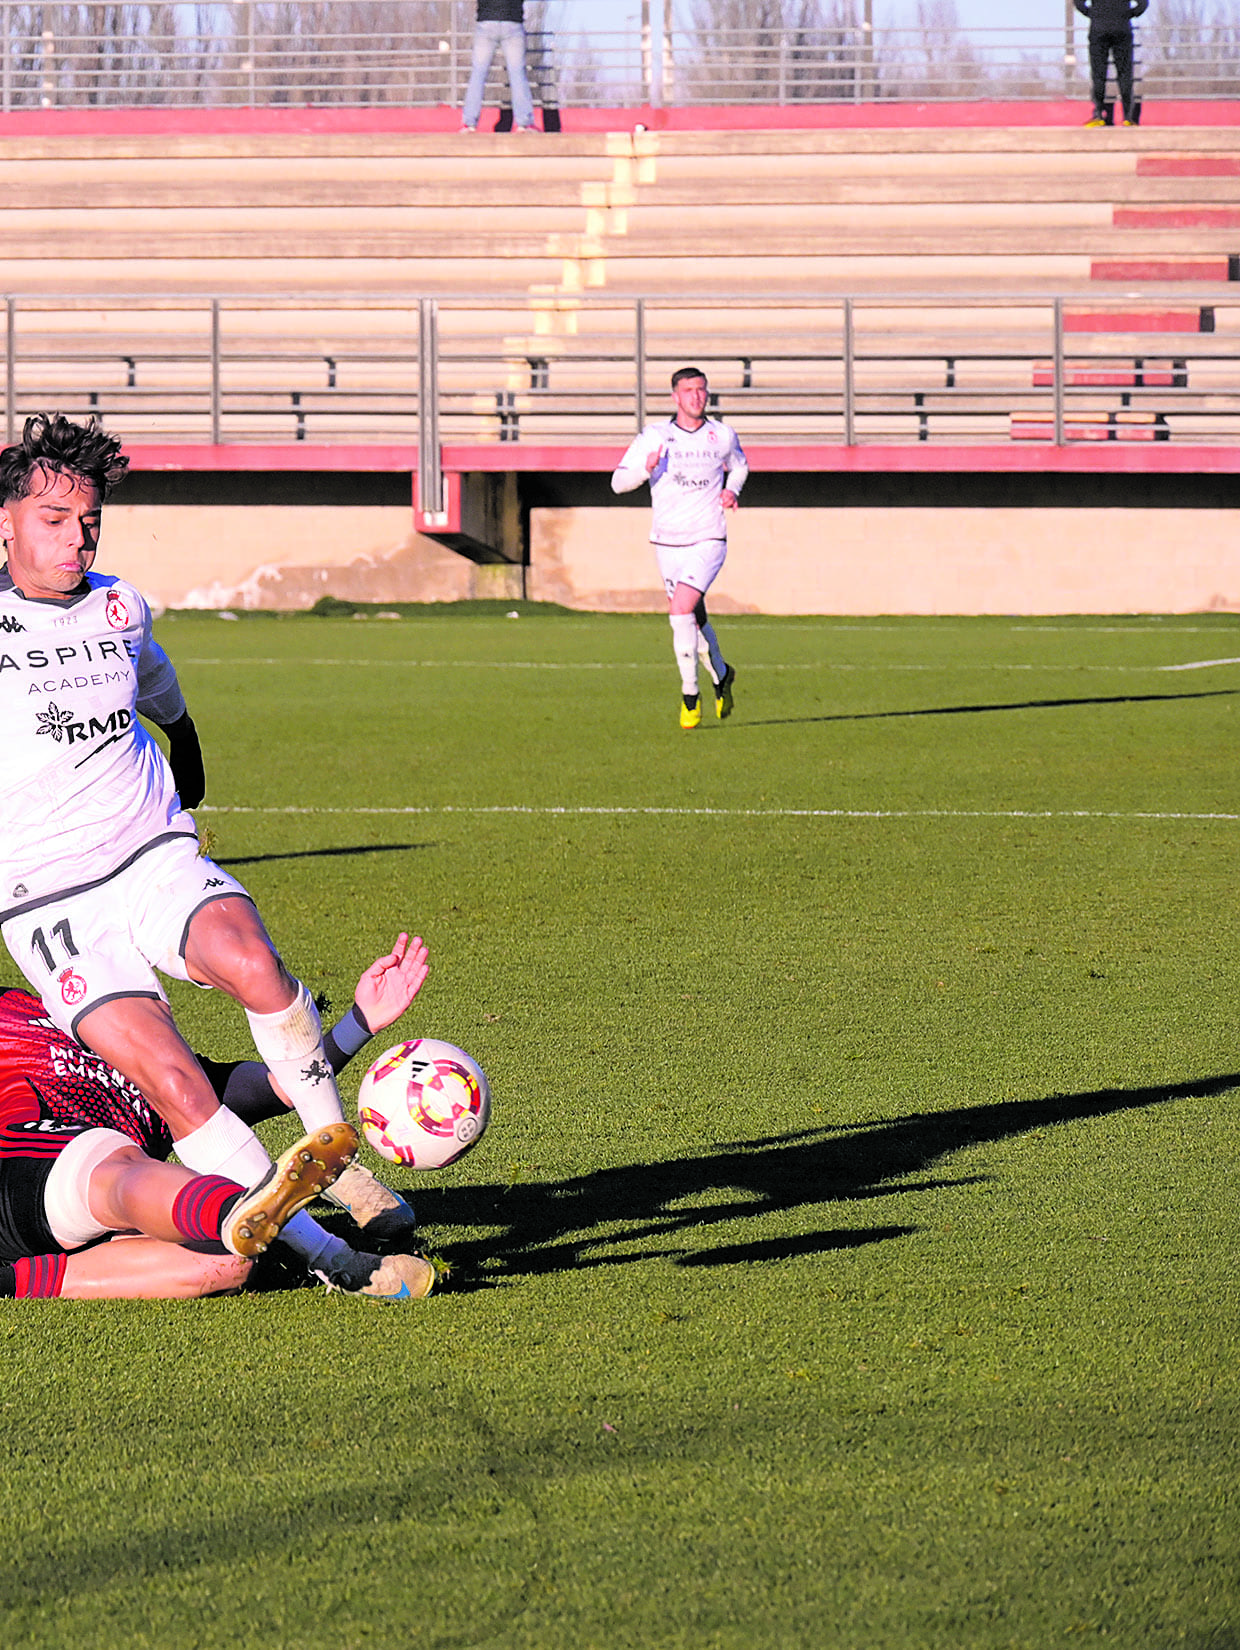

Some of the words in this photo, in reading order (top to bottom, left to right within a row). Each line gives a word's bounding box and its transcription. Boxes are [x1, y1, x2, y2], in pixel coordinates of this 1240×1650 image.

[53, 615, 78, 628] 1923
[28, 670, 130, 695] ACADEMY
[64, 708, 131, 745] RMD
[31, 918, 80, 975] 11
